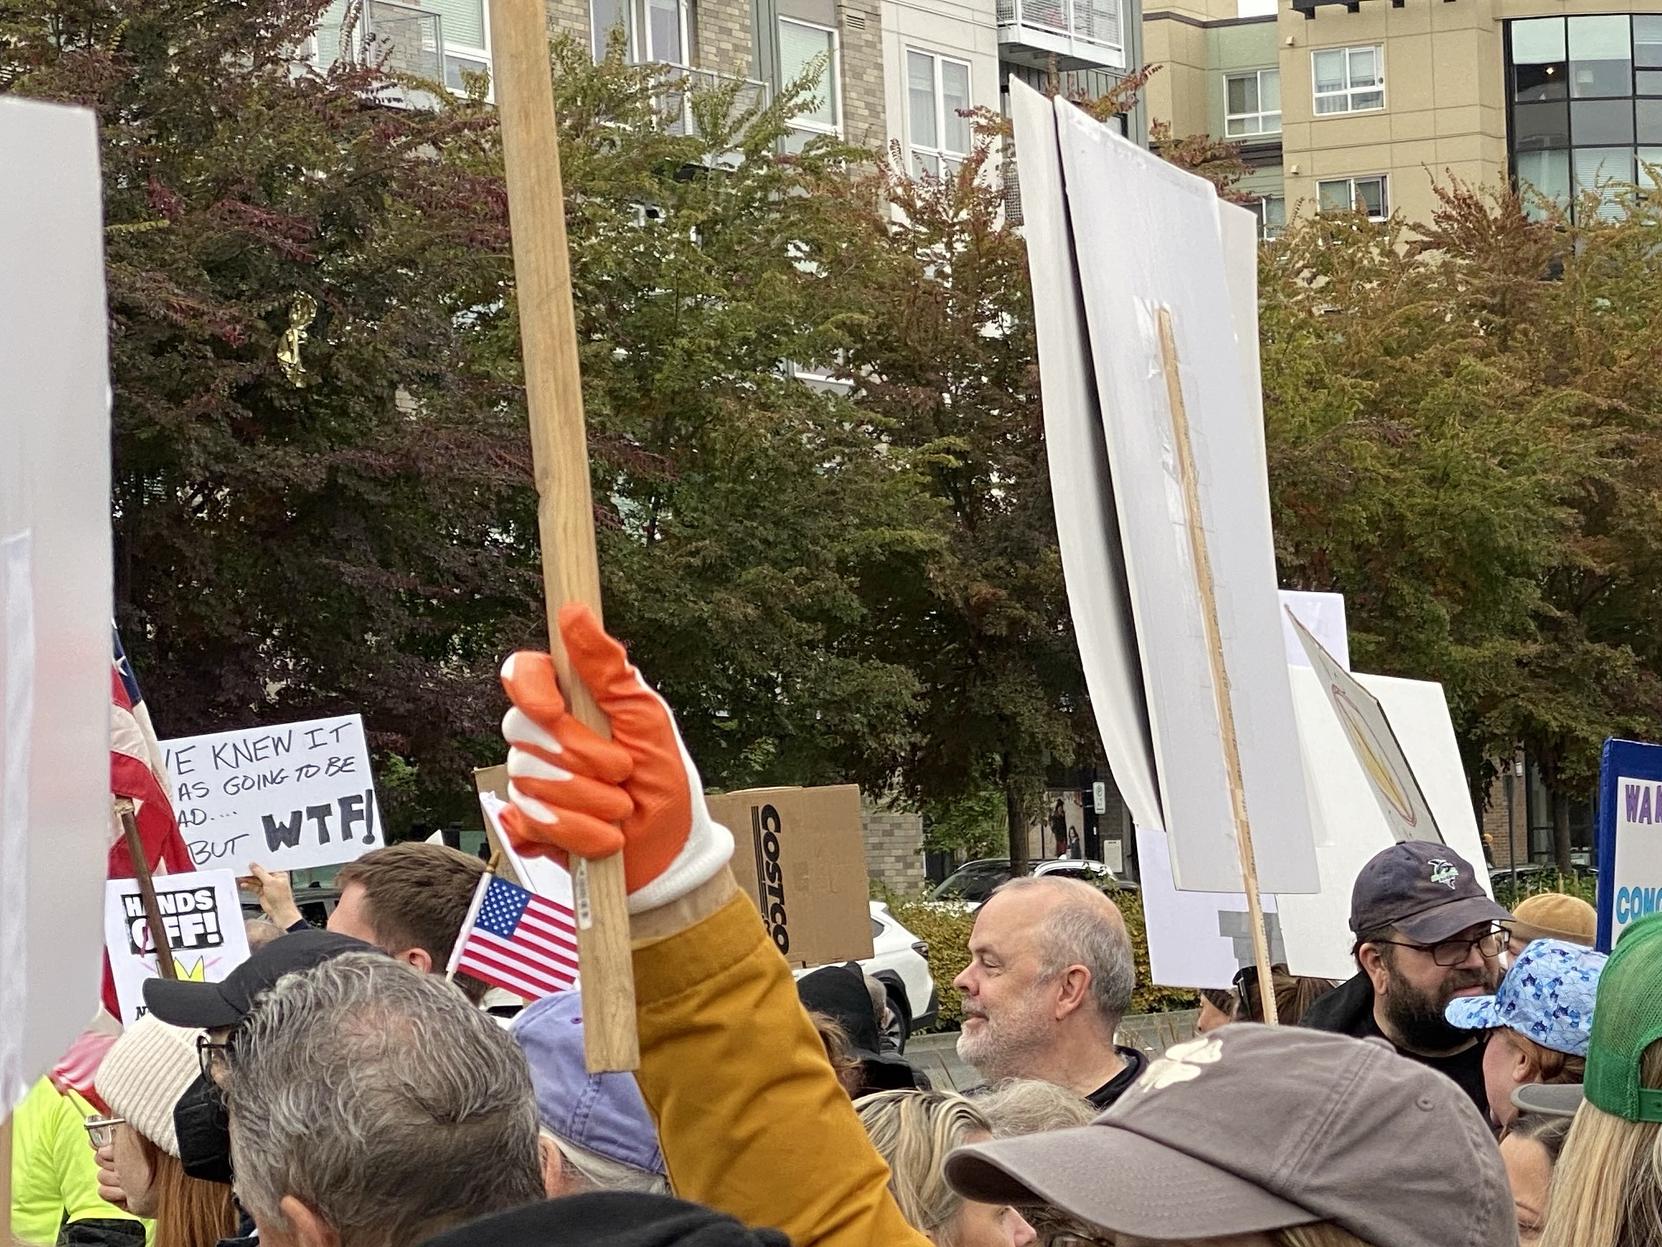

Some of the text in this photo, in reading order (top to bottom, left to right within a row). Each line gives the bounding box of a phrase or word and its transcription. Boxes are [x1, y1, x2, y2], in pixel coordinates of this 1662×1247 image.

[212, 729, 293, 771] KNEW
[304, 721, 353, 750] IT
[223, 767, 289, 796] GOING
[295, 764, 321, 783] TO
[325, 756, 356, 777] BE
[186, 788, 377, 865] BUT WTF!
[760, 803, 790, 956] COSTCO
[124, 889, 214, 917] HNDS
[131, 911, 221, 951] OFF!
